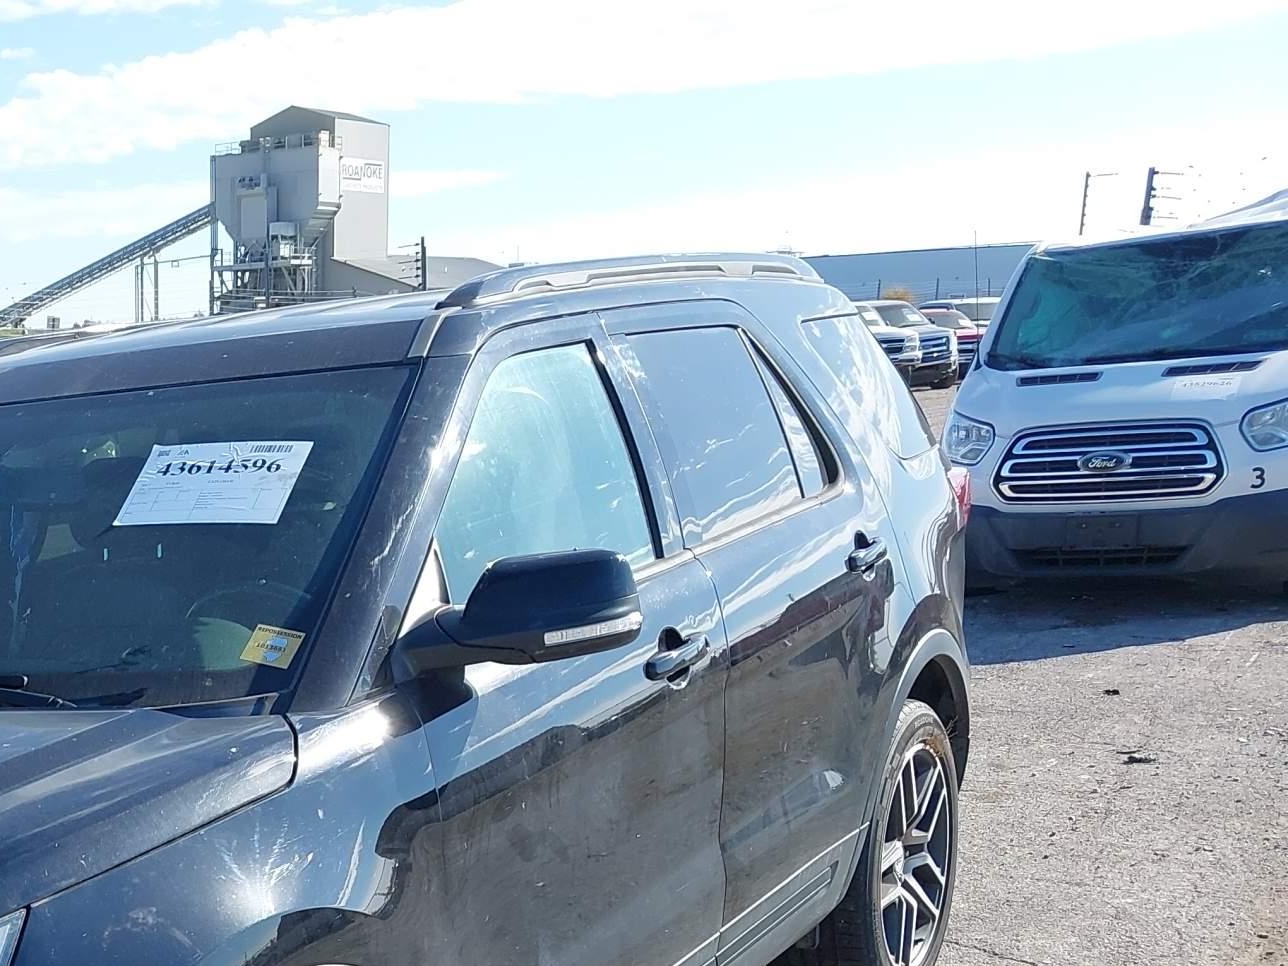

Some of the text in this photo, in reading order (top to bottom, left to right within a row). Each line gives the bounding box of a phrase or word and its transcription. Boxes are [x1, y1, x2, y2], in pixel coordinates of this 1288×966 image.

[341, 163, 383, 179] ROANOKE
[157, 459, 282, 476] 43614596
[1088, 456, 1117, 468] Ford
[1250, 467, 1265, 489] 3
